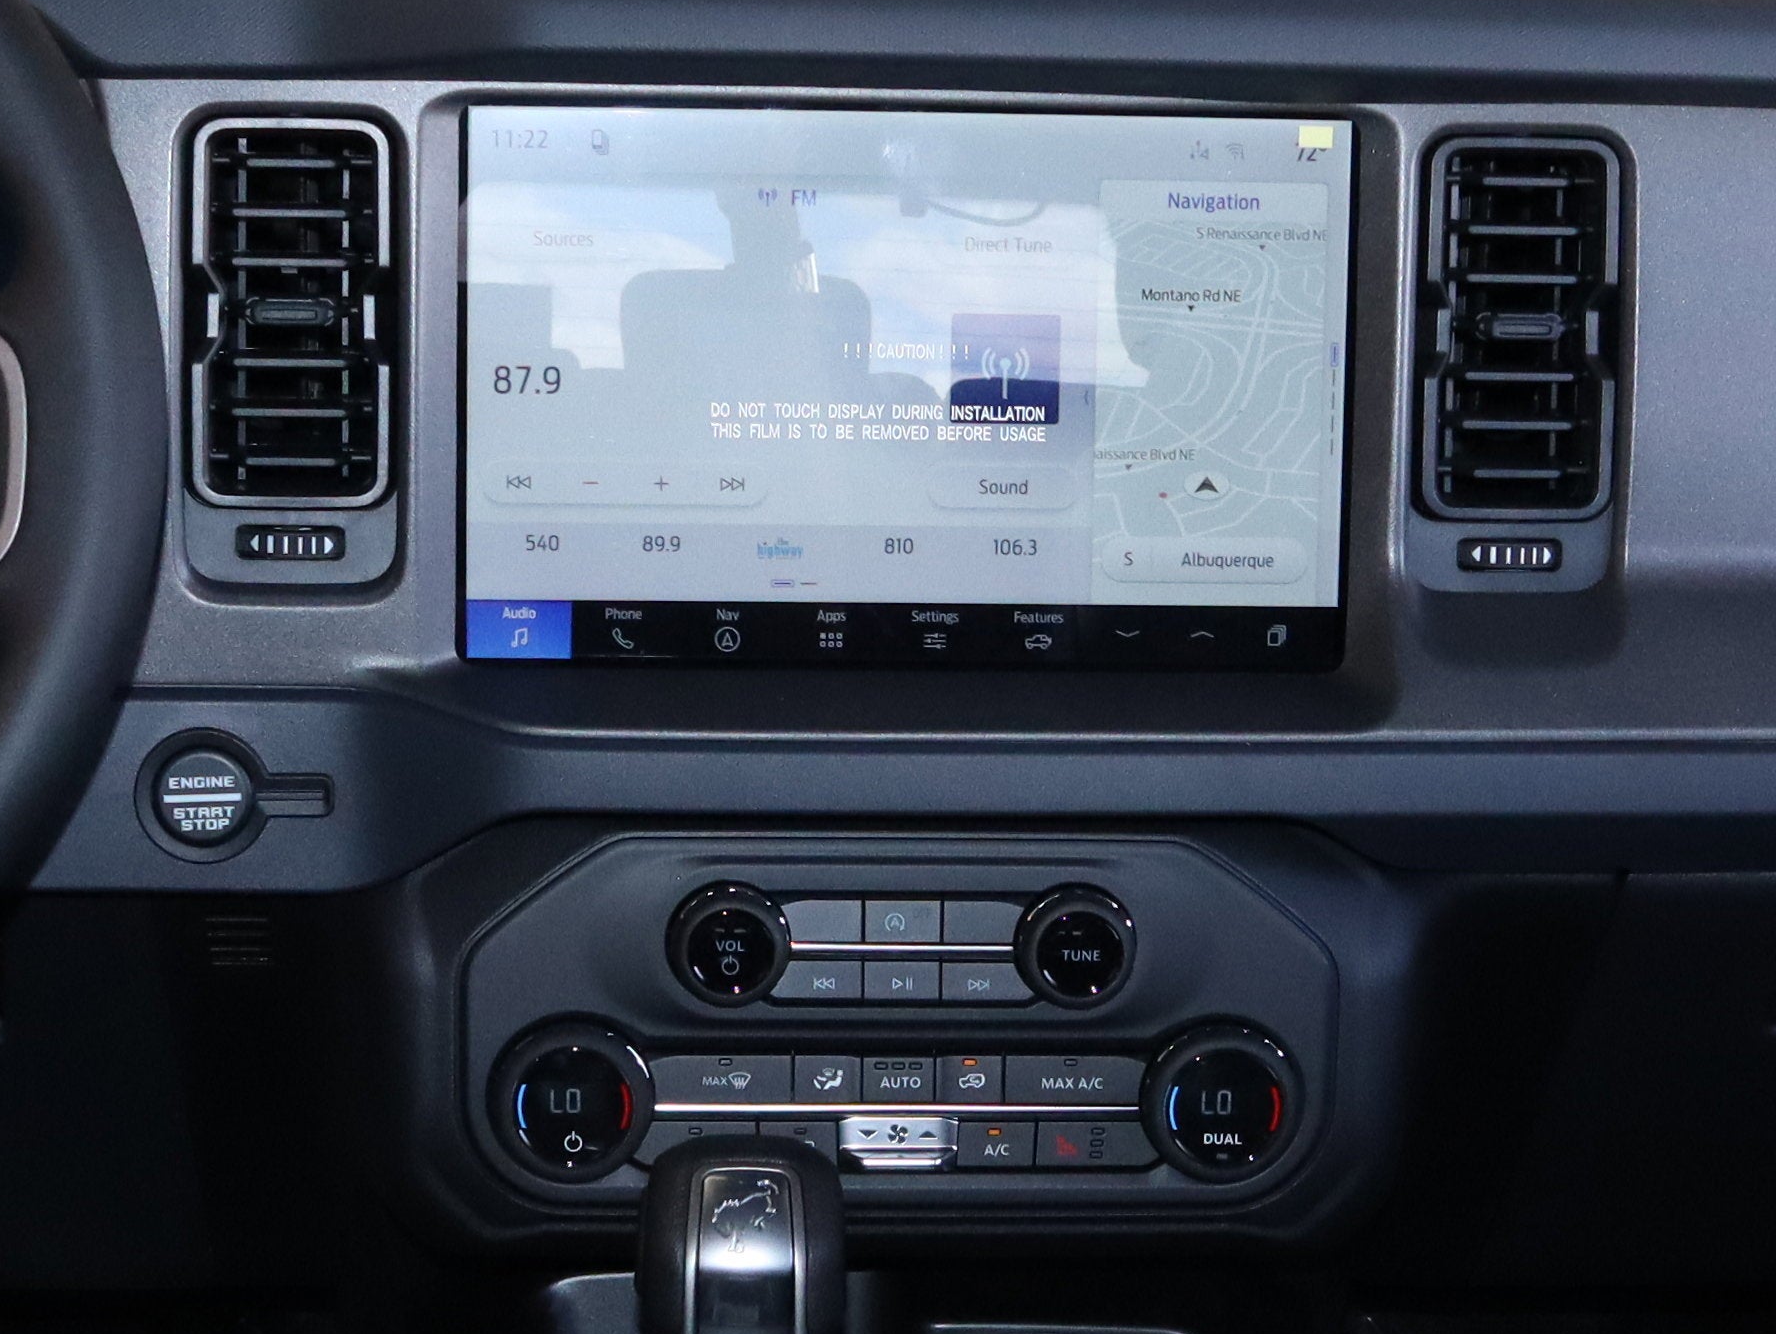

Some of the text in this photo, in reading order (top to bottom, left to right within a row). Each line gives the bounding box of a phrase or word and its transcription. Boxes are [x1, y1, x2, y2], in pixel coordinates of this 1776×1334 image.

[492, 129, 549, 150] 11:22
[791, 189, 817, 207] FM
[1168, 192, 1260, 213] Navigation
[533, 230, 594, 248] Sources
[1196, 227, 1205, 240] S
[1207, 227, 1281, 241] Renaissance
[1284, 228, 1310, 242] Blvd
[965, 236, 1052, 254] Direct Tune
[1141, 288, 1241, 303] Montano Rd NE
[493, 366, 562, 395] 87.9
[711, 402, 1046, 422] DO NOT TOUCH DISPLAY DURING INSTALLATION
[711, 422, 1046, 442] THIS FILM IS TO BE REMOVED BEFORE USAGE
[1093, 447, 1195, 461] aissance Blvd NE
[979, 479, 1028, 496] Sound
[526, 535, 560, 553] 540
[642, 535, 681, 553] 89.9
[884, 538, 914, 555] 810
[993, 538, 1038, 556] 106.3
[1124, 552, 1133, 566] S
[1181, 552, 1274, 570] Albuquerque
[502, 607, 536, 620] Audio
[605, 607, 642, 621] Phone
[716, 609, 739, 622] Nav
[817, 609, 846, 625] Apps
[911, 610, 959, 626] Settings
[1014, 611, 1063, 624] Features
[168, 775, 235, 789] ENGINE
[173, 806, 235, 819] START
[181, 818, 230, 831] STOP
[715, 940, 745, 954] VOL
[1062, 949, 1101, 962] TUNE
[702, 1076, 728, 1087] MAX
[880, 1075, 921, 1089] AUTO
[1041, 1077, 1104, 1090] MAX A/C
[1203, 1133, 1242, 1146] DUAL
[984, 1143, 1010, 1157] A/C
